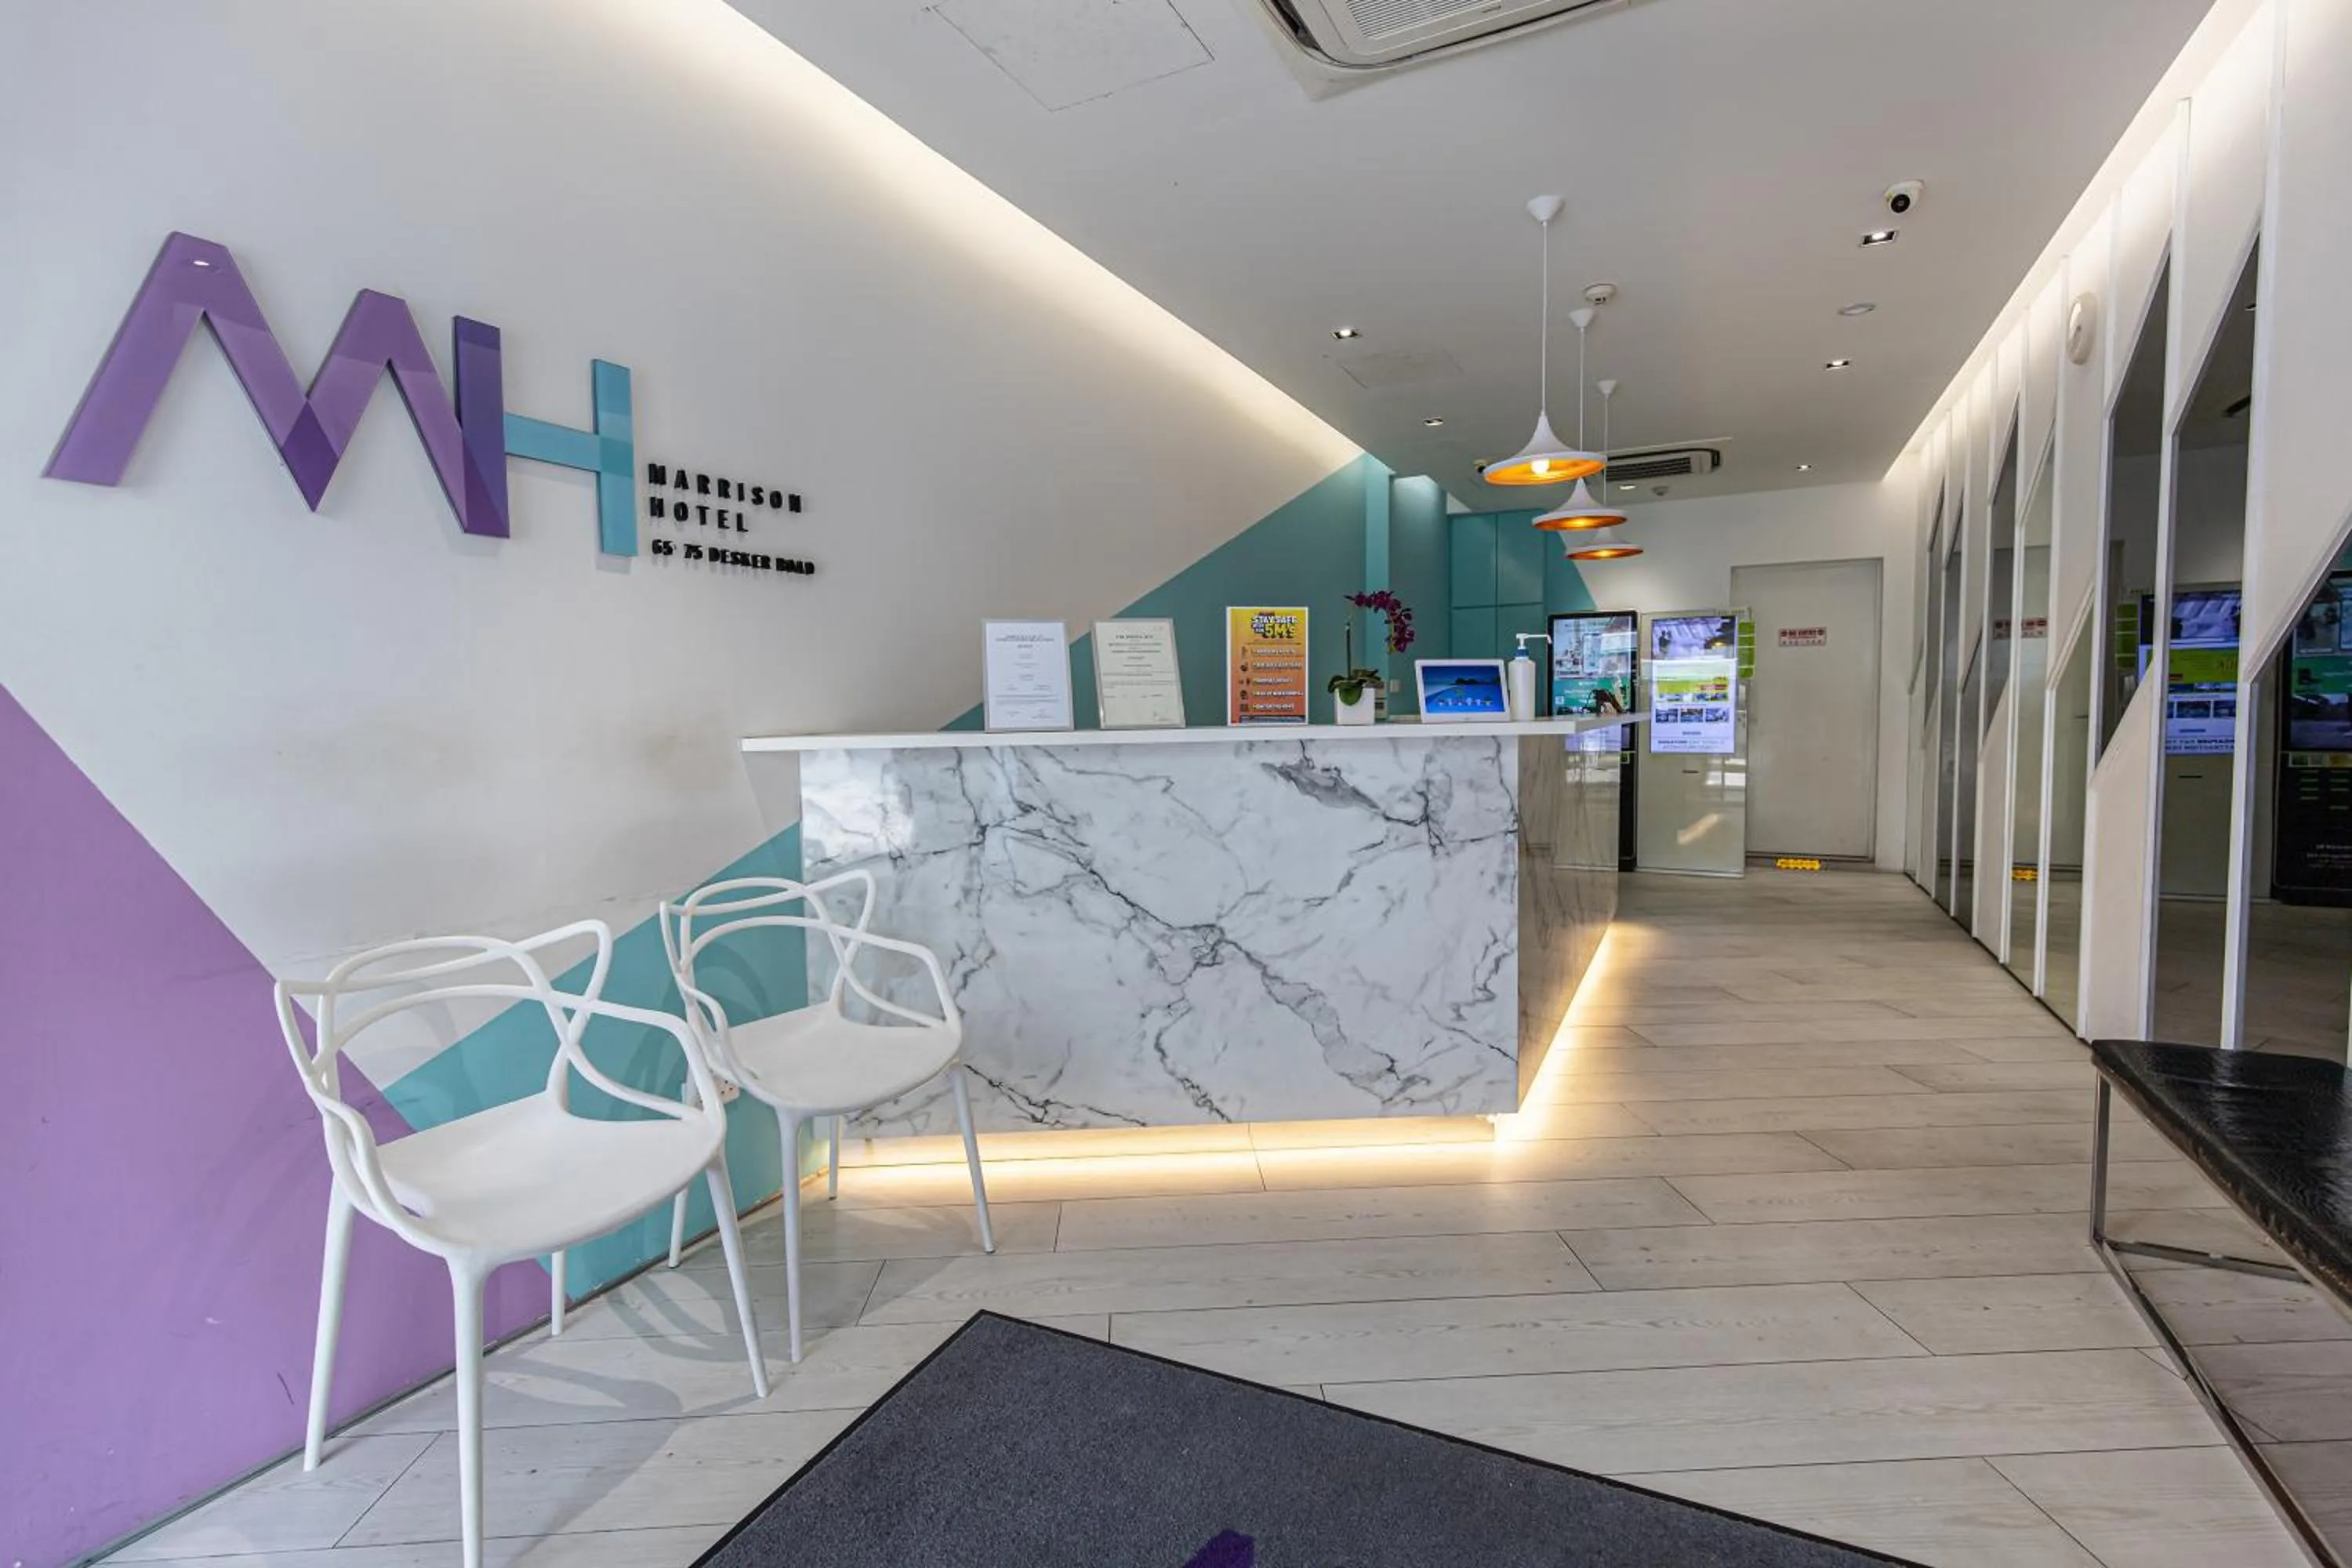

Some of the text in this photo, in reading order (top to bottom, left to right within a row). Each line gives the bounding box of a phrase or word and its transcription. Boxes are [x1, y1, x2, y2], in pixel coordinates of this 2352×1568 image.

[648, 463, 802, 514] MARRISON
[650, 496, 749, 533] HOTEL
[709, 546, 771, 570] DESKER
